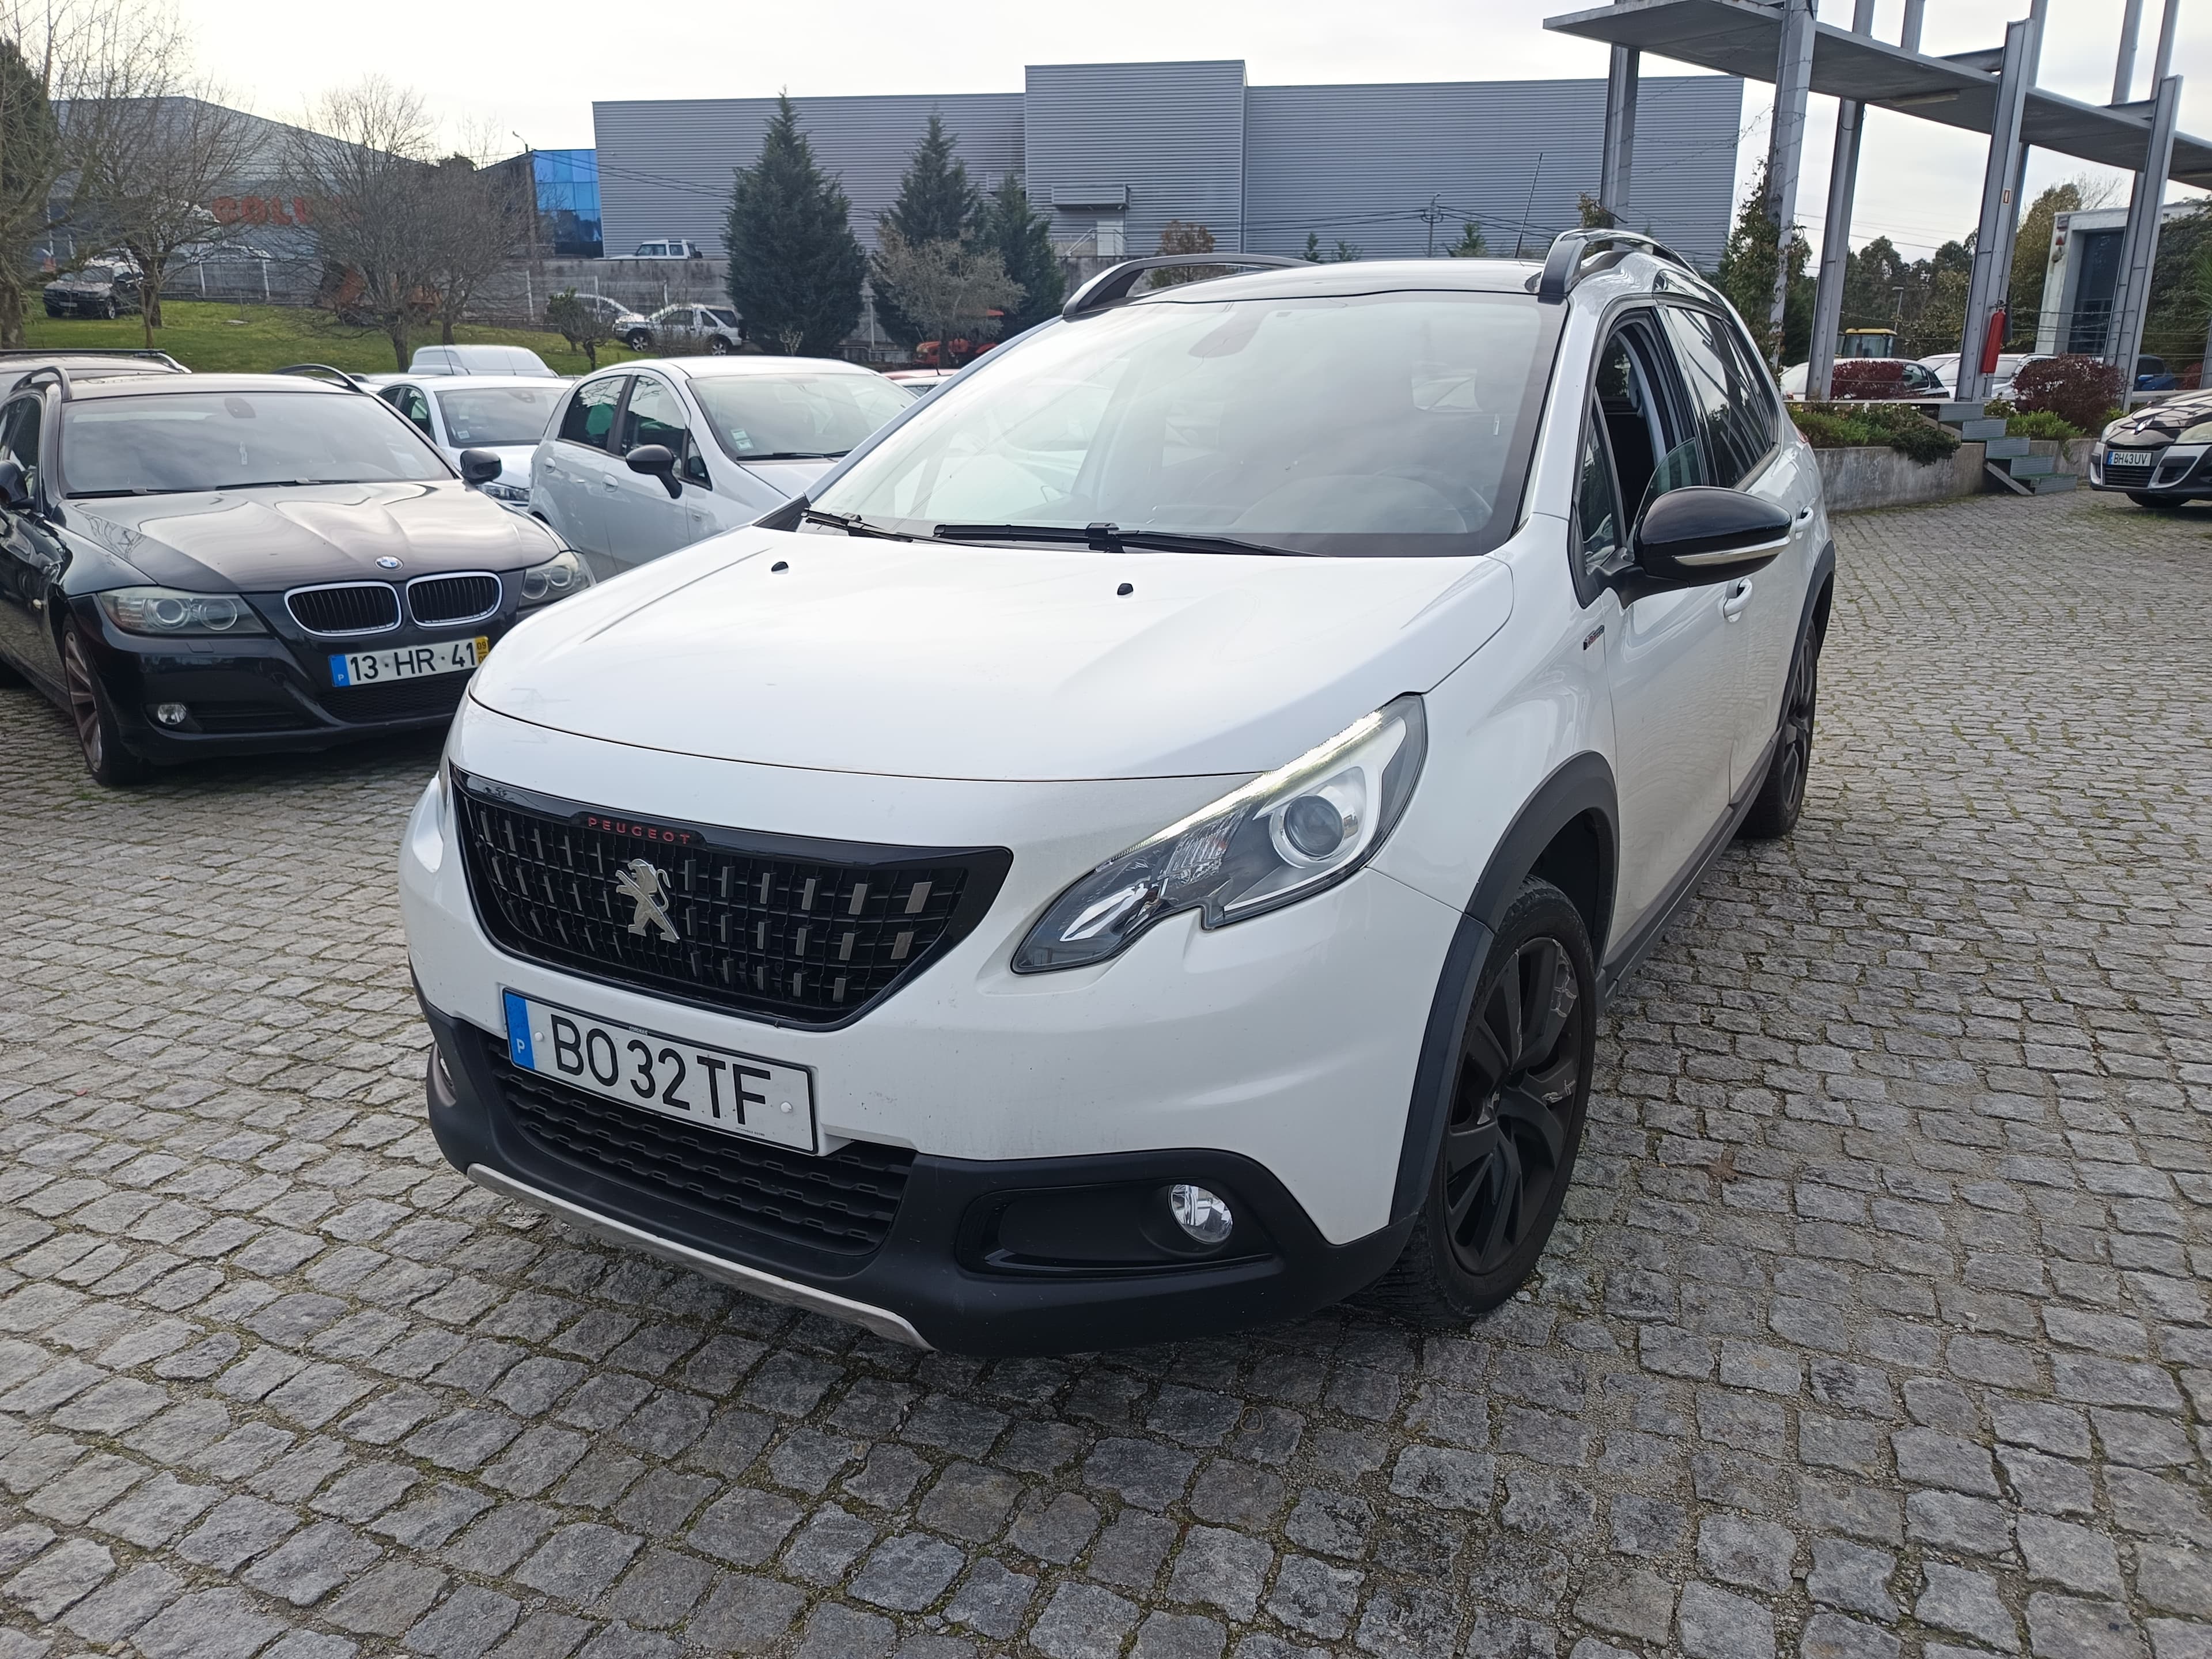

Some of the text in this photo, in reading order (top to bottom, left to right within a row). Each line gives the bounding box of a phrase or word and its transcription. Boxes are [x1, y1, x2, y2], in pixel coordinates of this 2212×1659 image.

[2113, 453, 2147, 464] BH43UV
[477, 641, 487, 650] 09
[588, 816, 690, 844] PEUGEOT
[517, 1038, 525, 1054] P
